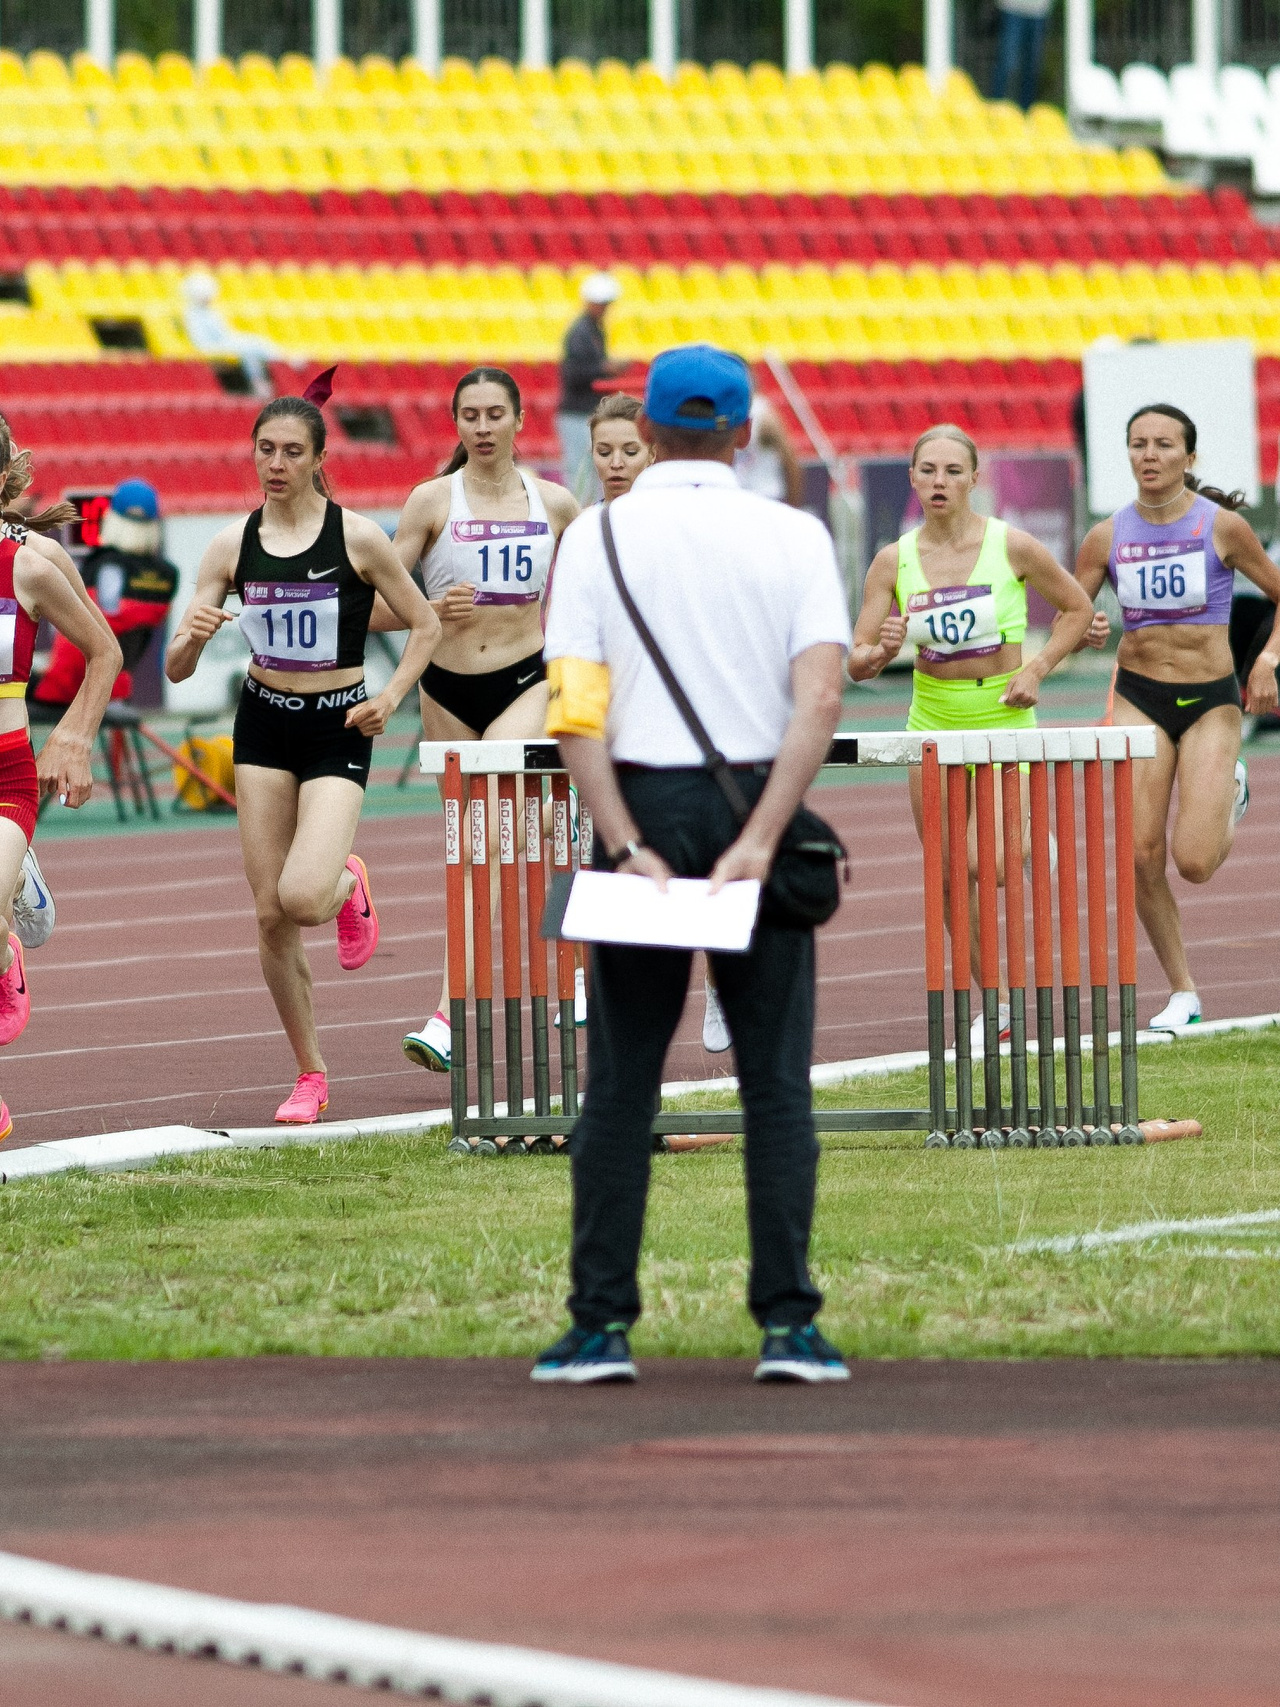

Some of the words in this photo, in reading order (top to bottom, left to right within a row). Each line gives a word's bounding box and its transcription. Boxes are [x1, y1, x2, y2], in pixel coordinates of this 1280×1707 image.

[478, 545, 532, 582] 115
[1136, 564, 1186, 600] 156
[262, 609, 317, 648] 110
[925, 609, 976, 645] 162
[259, 686, 305, 710] PRO
[316, 683, 366, 710] NIKE
[447, 801, 458, 856] POLANIK
[472, 801, 483, 856] POLANIK
[500, 801, 511, 856] POLANIK
